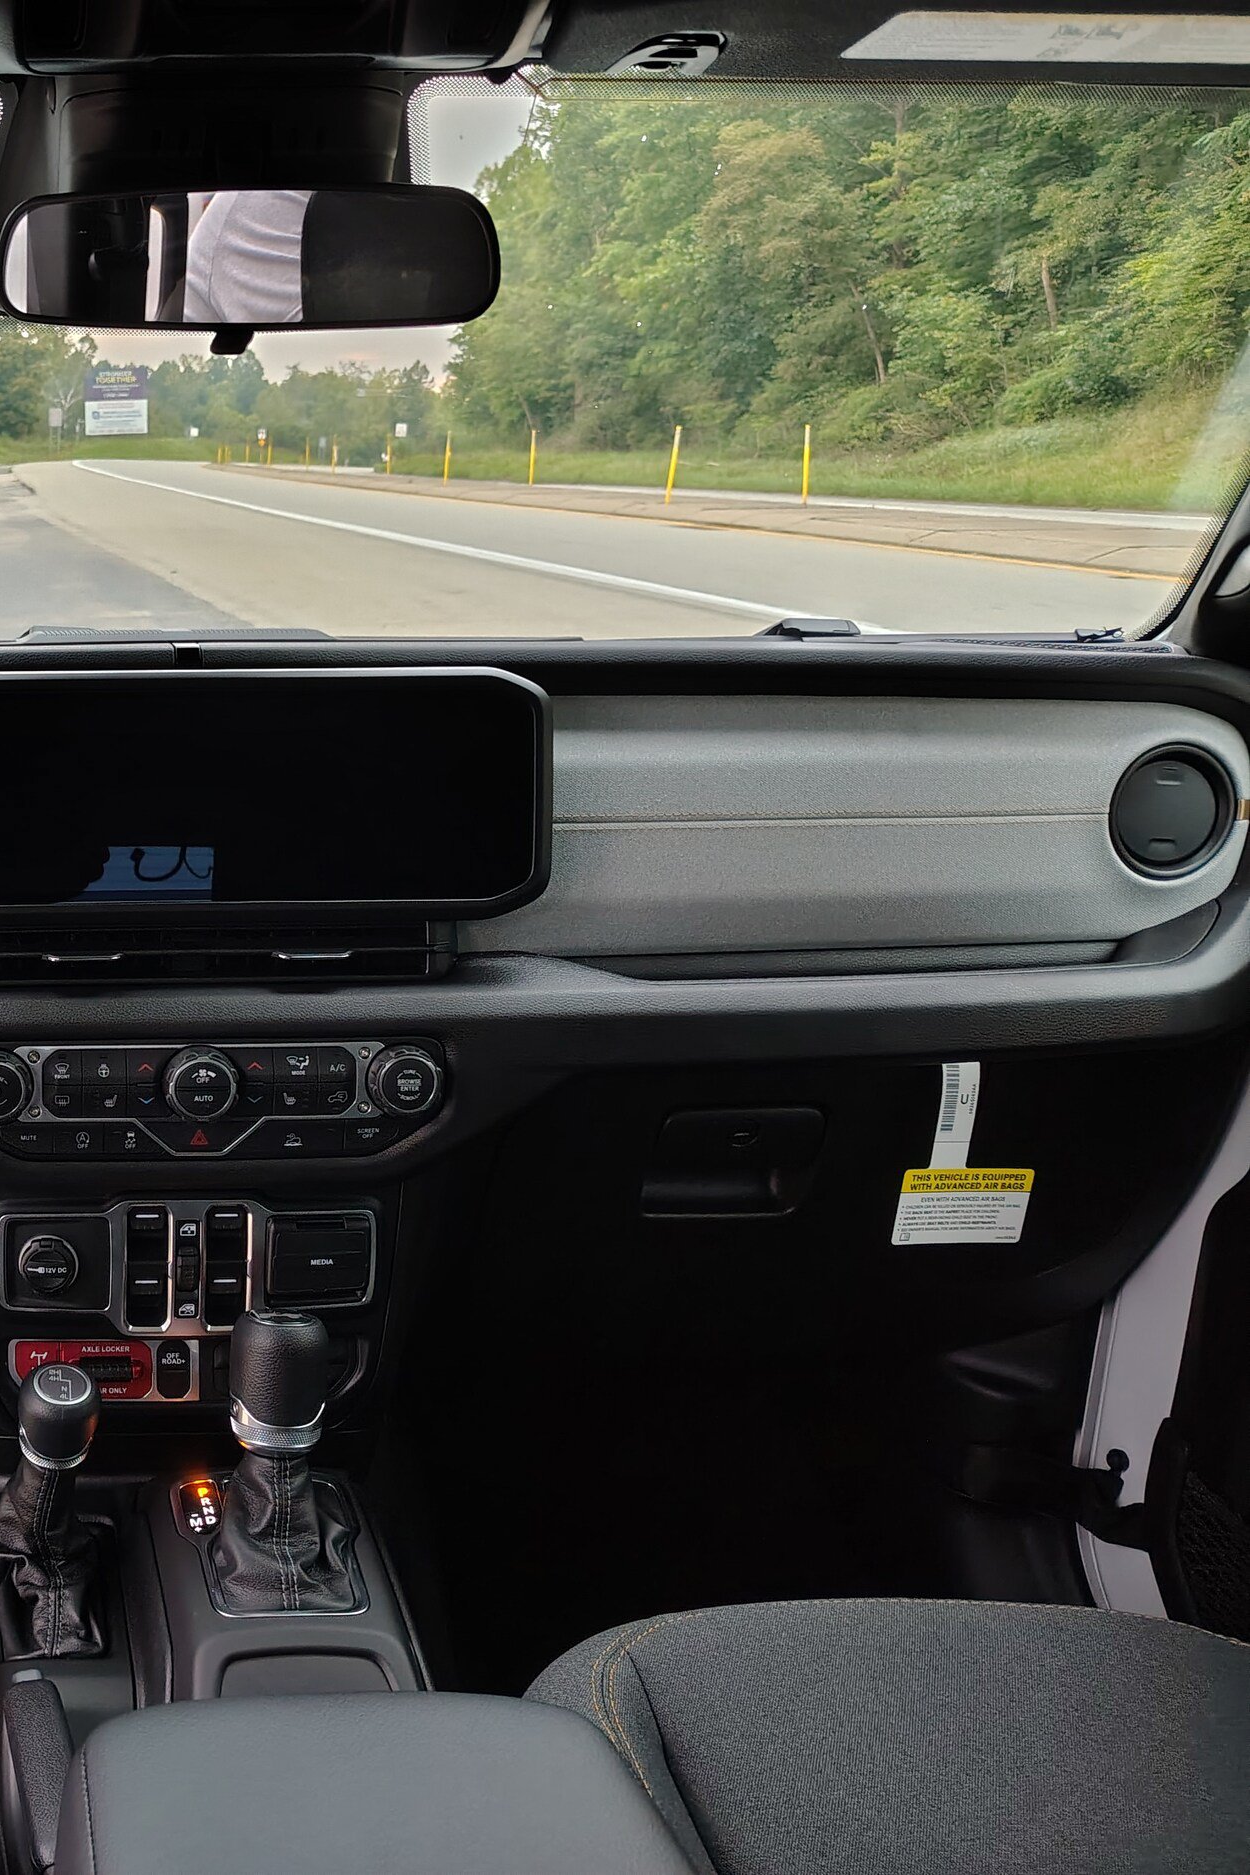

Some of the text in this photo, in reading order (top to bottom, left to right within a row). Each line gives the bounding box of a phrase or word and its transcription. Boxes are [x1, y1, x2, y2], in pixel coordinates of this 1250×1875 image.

[329, 1064, 347, 1072] A/C
[960, 1093, 969, 1105] U
[912, 1173, 1027, 1182] THIS VEHICLE IS EQUIPPED
[910, 1182, 1025, 1191] WITH ADVANCED AIR BAGS
[310, 1258, 334, 1266] MEDIA
[81, 1345, 130, 1353] AXLE LOCKER
[197, 1487, 208, 1498] P
[200, 1497, 212, 1506] R
[202, 1506, 215, 1516] N
[189, 1517, 203, 1527] M
[205, 1515, 216, 1525] D
